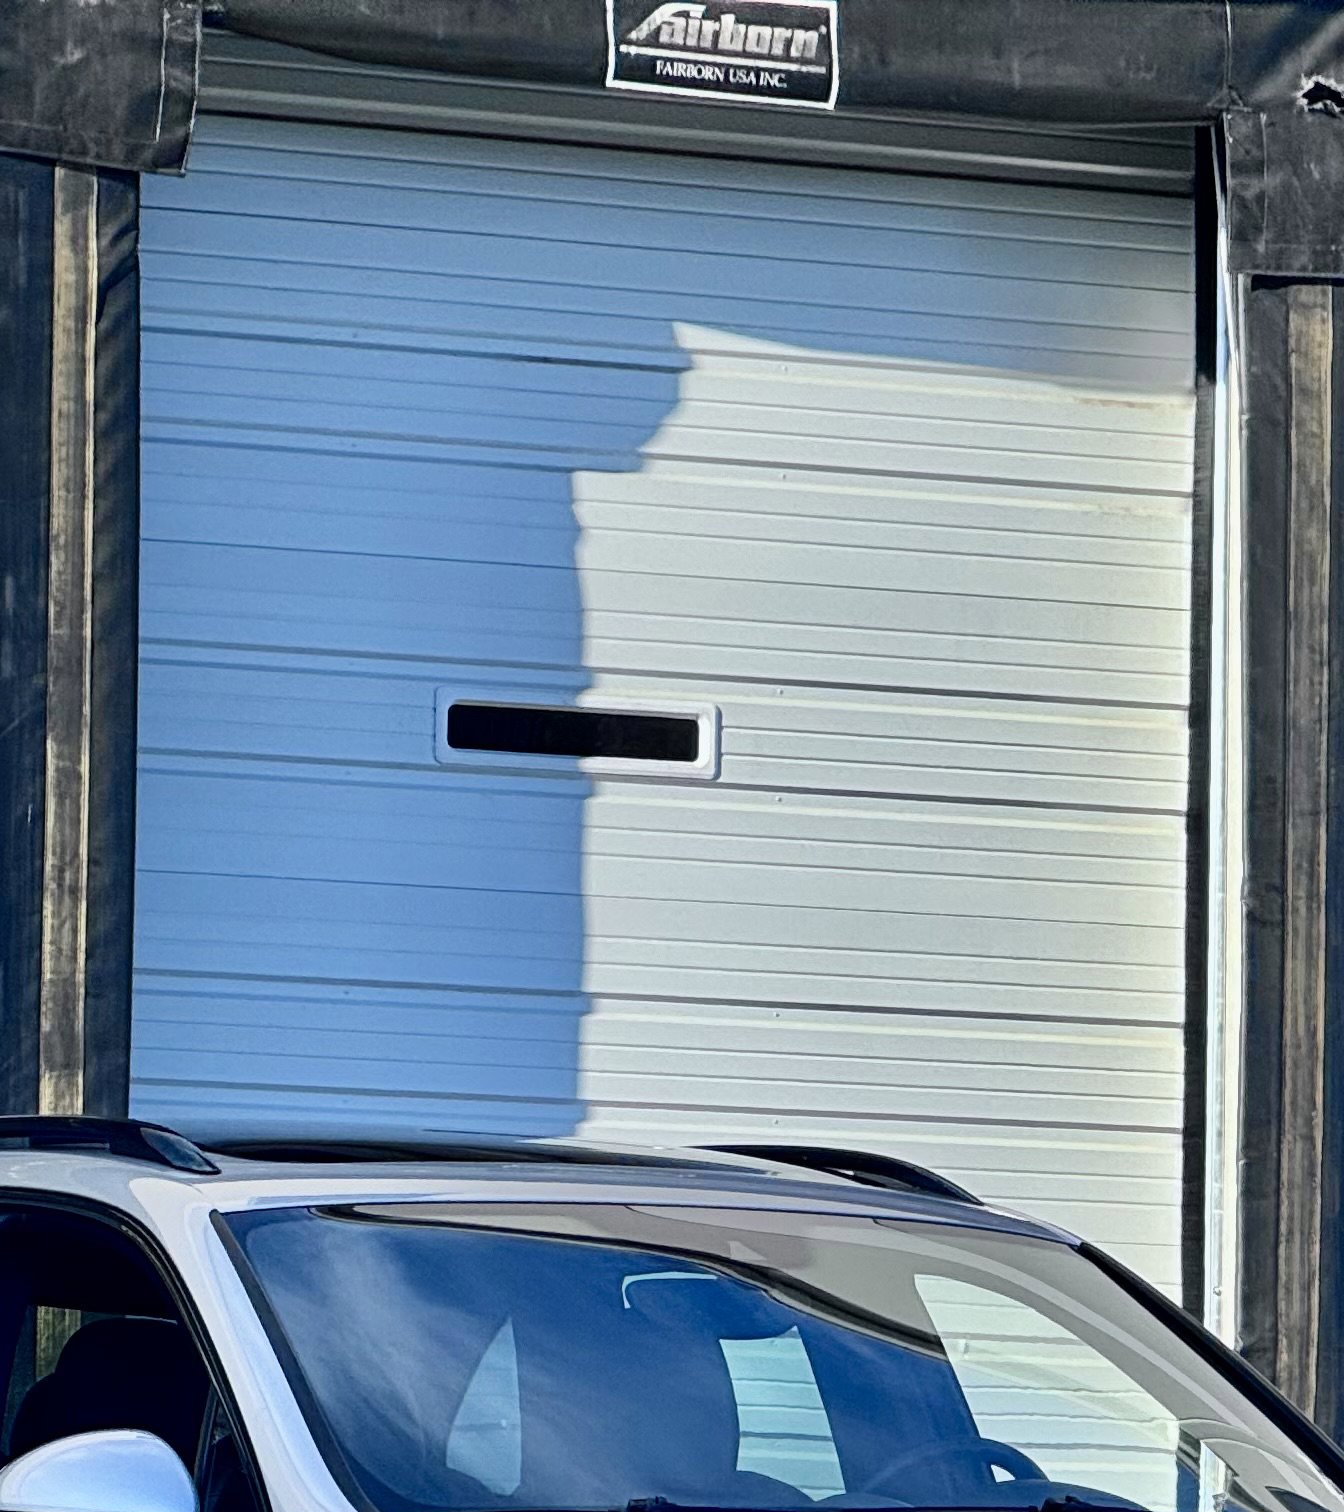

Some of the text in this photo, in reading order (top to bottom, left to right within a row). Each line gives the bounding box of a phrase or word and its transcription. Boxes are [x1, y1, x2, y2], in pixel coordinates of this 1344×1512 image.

[656, 59, 788, 89] FAIRBORN USA INC.
